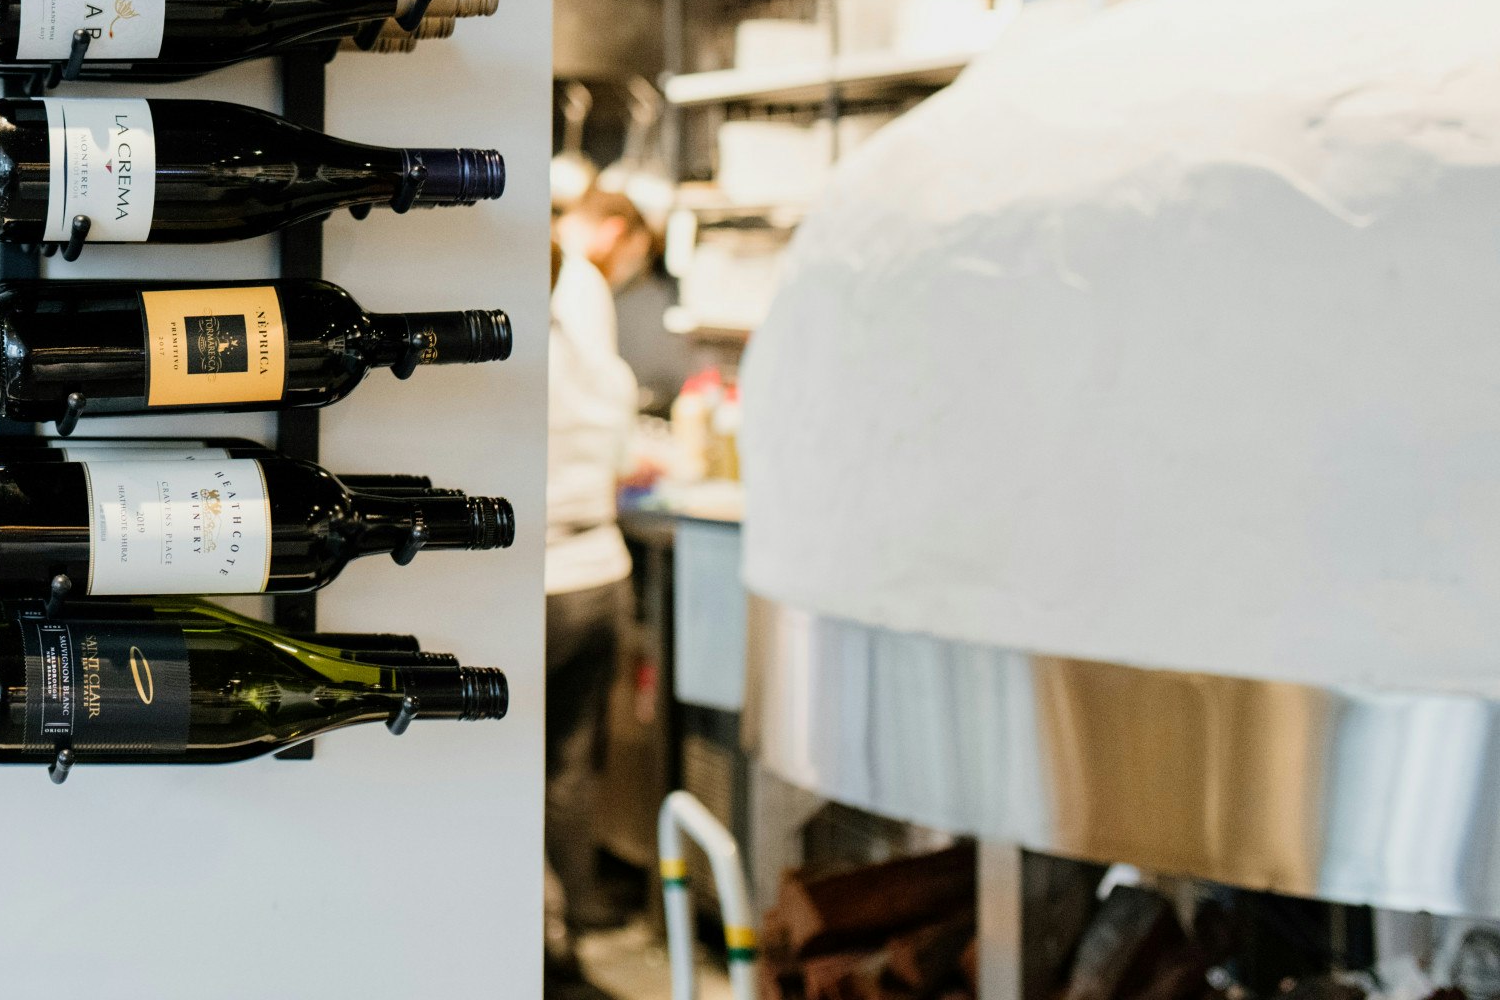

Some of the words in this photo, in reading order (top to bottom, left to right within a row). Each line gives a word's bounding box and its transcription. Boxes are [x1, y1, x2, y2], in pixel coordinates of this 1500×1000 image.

[115, 115, 129, 136] LA
[80, 134, 88, 197] MONTEREY
[115, 143, 131, 221] CREMA
[170, 322, 179, 370] PRIMITIVO
[207, 318, 216, 372] TORMARESCA
[117, 485, 127, 531] HEATHCOTE
[136, 511, 146, 533] 2019
[161, 481, 172, 527] CRAVENS
[191, 491, 202, 554] WINERY
[214, 471, 242, 576] HEATHCOTE
[165, 533, 173, 565] PLACE
[59, 635, 69, 684] SAUVIGNON
[86, 635, 100, 670] SAINT
[83, 674, 91, 707] ESTATE
[88, 674, 100, 719] CLAIR
